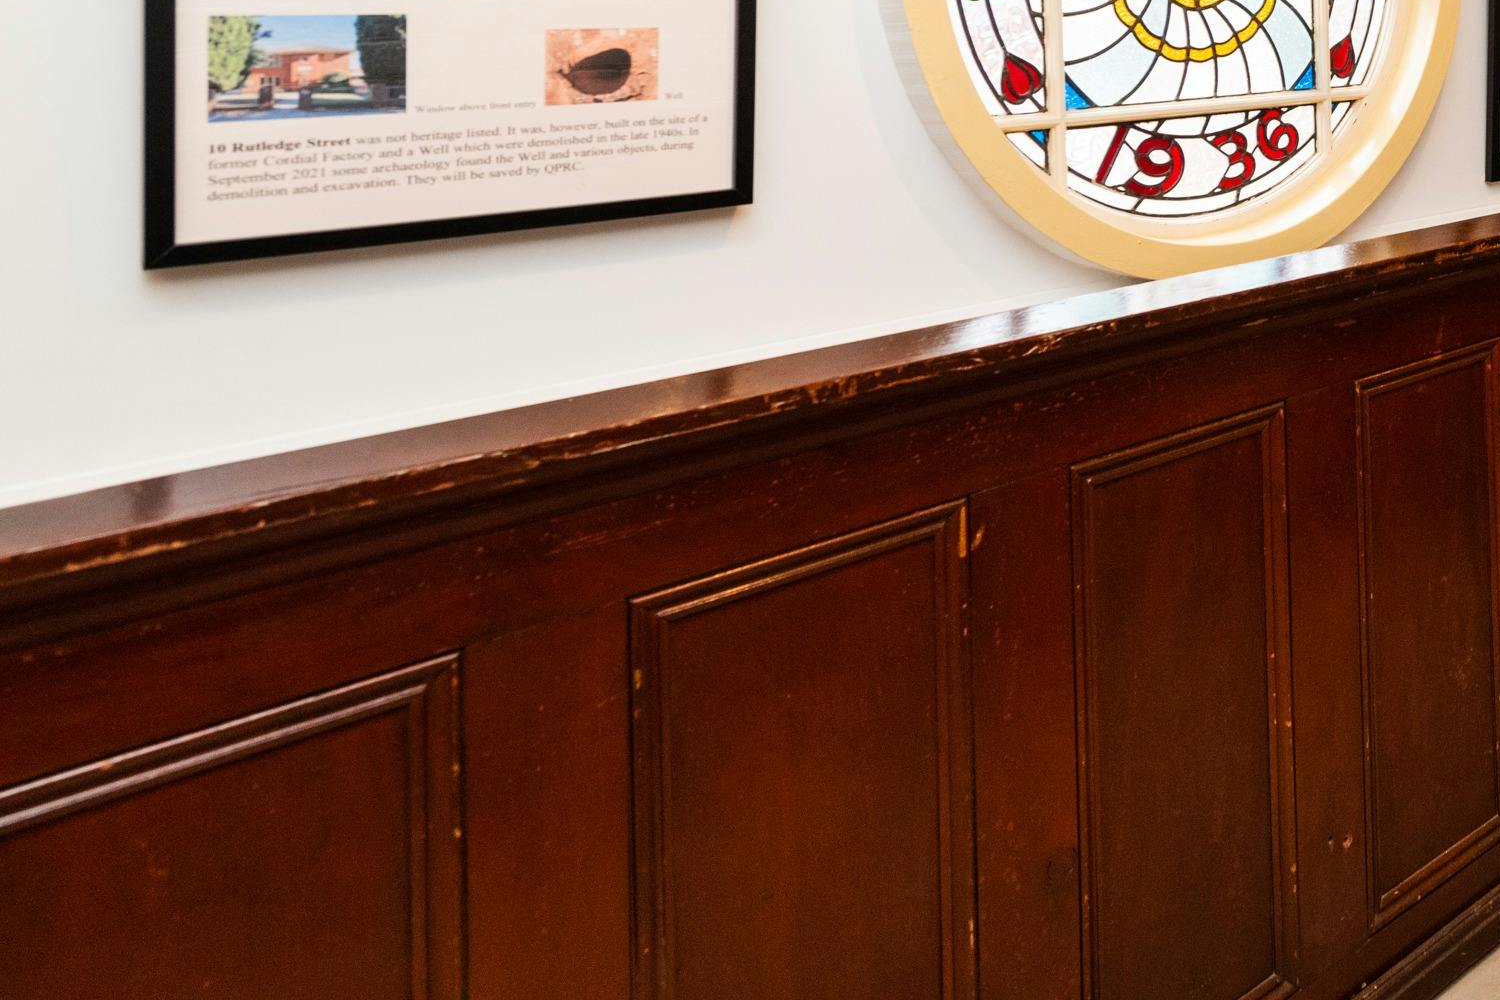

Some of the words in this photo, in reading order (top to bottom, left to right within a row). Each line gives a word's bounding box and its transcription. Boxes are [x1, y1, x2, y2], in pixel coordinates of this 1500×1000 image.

[208, 160, 258, 170] former
[263, 153, 318, 166] Cordial
[322, 152, 374, 162] Factory
[378, 147, 403, 158] and
[419, 144, 450, 155] Well
[453, 141, 491, 152] which
[495, 141, 524, 149] were
[527, 134, 593, 147] demolished
[596, 134, 608, 142] in
[610, 132, 628, 141] the
[630, 131, 649, 140] late
[689, 127, 700, 135] In
[209, 143, 227, 154] 10
[232, 140, 302, 153] Rutledge
[306, 137, 351, 148] Street
[356, 136, 382, 144] was
[386, 133, 407, 142] not
[411, 131, 463, 141] heritage
[507, 126, 516, 134] It
[520, 126, 546, 134] was,
[549, 123, 602, 132] however,
[604, 119, 630, 128] built
[648, 117, 665, 125] the
[668, 116, 686, 124] site
[688, 114, 700, 123] of
[1095, 109, 1300, 198] 1936
[206, 187, 288, 202] demolition
[292, 183, 319, 194] and
[405, 174, 438, 185] They
[442, 171, 466, 181] will
[470, 170, 485, 179] be
[488, 166, 523, 177] saved
[526, 165, 541, 176] by
[208, 172, 287, 187] September
[292, 168, 325, 179] 2021
[331, 167, 368, 176] some
[372, 160, 450, 173] archaeology
[456, 155, 492, 166] found
[495, 154, 514, 163] the
[518, 151, 546, 161] Well
[548, 149, 570, 159] and
[573, 147, 614, 157] various
[617, 144, 658, 155] objects,
[660, 141, 694, 150] during
